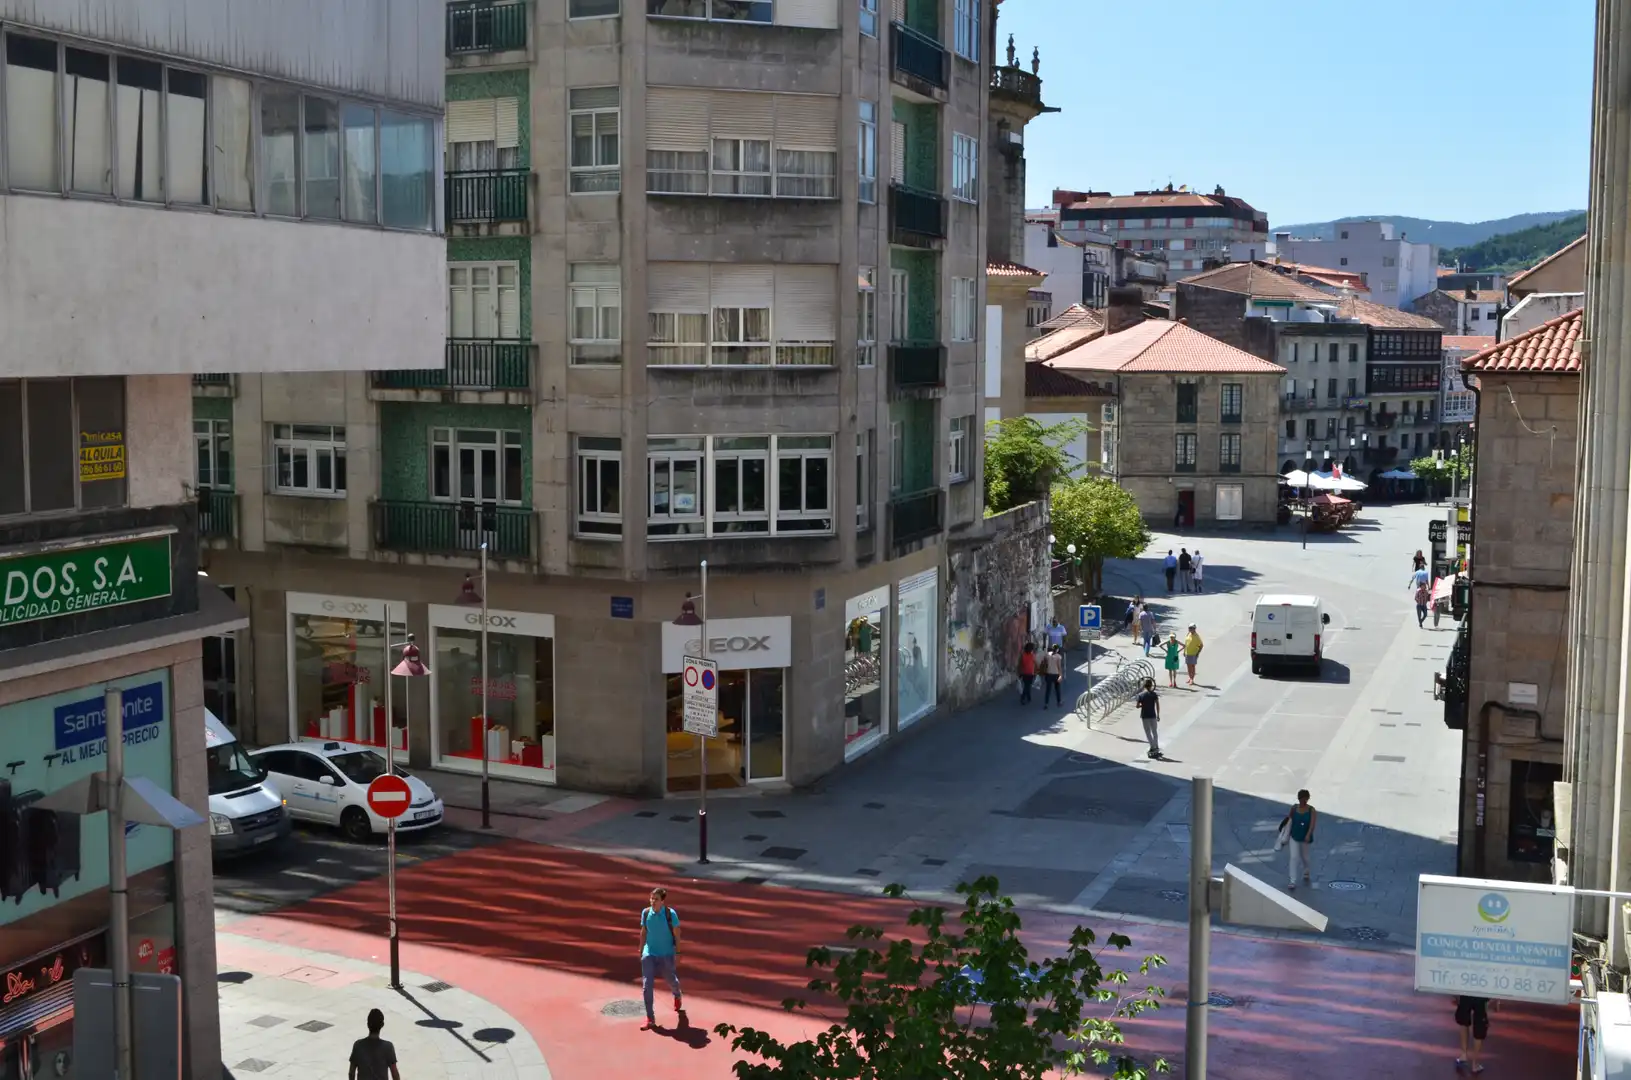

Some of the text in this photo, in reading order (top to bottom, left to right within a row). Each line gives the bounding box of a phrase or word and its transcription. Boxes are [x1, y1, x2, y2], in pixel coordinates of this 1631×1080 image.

[80, 447, 122, 461] ALQUILA
[92, 554, 143, 591] S.A.
[66, 588, 128, 611] GENERAL
[464, 612, 517, 629] GEOX
[1083, 609, 1096, 625] P
[684, 635, 771, 654] GEOX
[63, 696, 153, 735] Samsnite
[61, 748, 77, 766] AL
[79, 739, 108, 761] MEJO
[1472, 940, 1512, 954] DENTAL
[1516, 944, 1564, 958] INFANTIL
[1460, 972, 1488, 988] 986
[1493, 975, 1510, 989] 10
[1513, 977, 1533, 992] 88
[1537, 980, 1557, 994] 87
